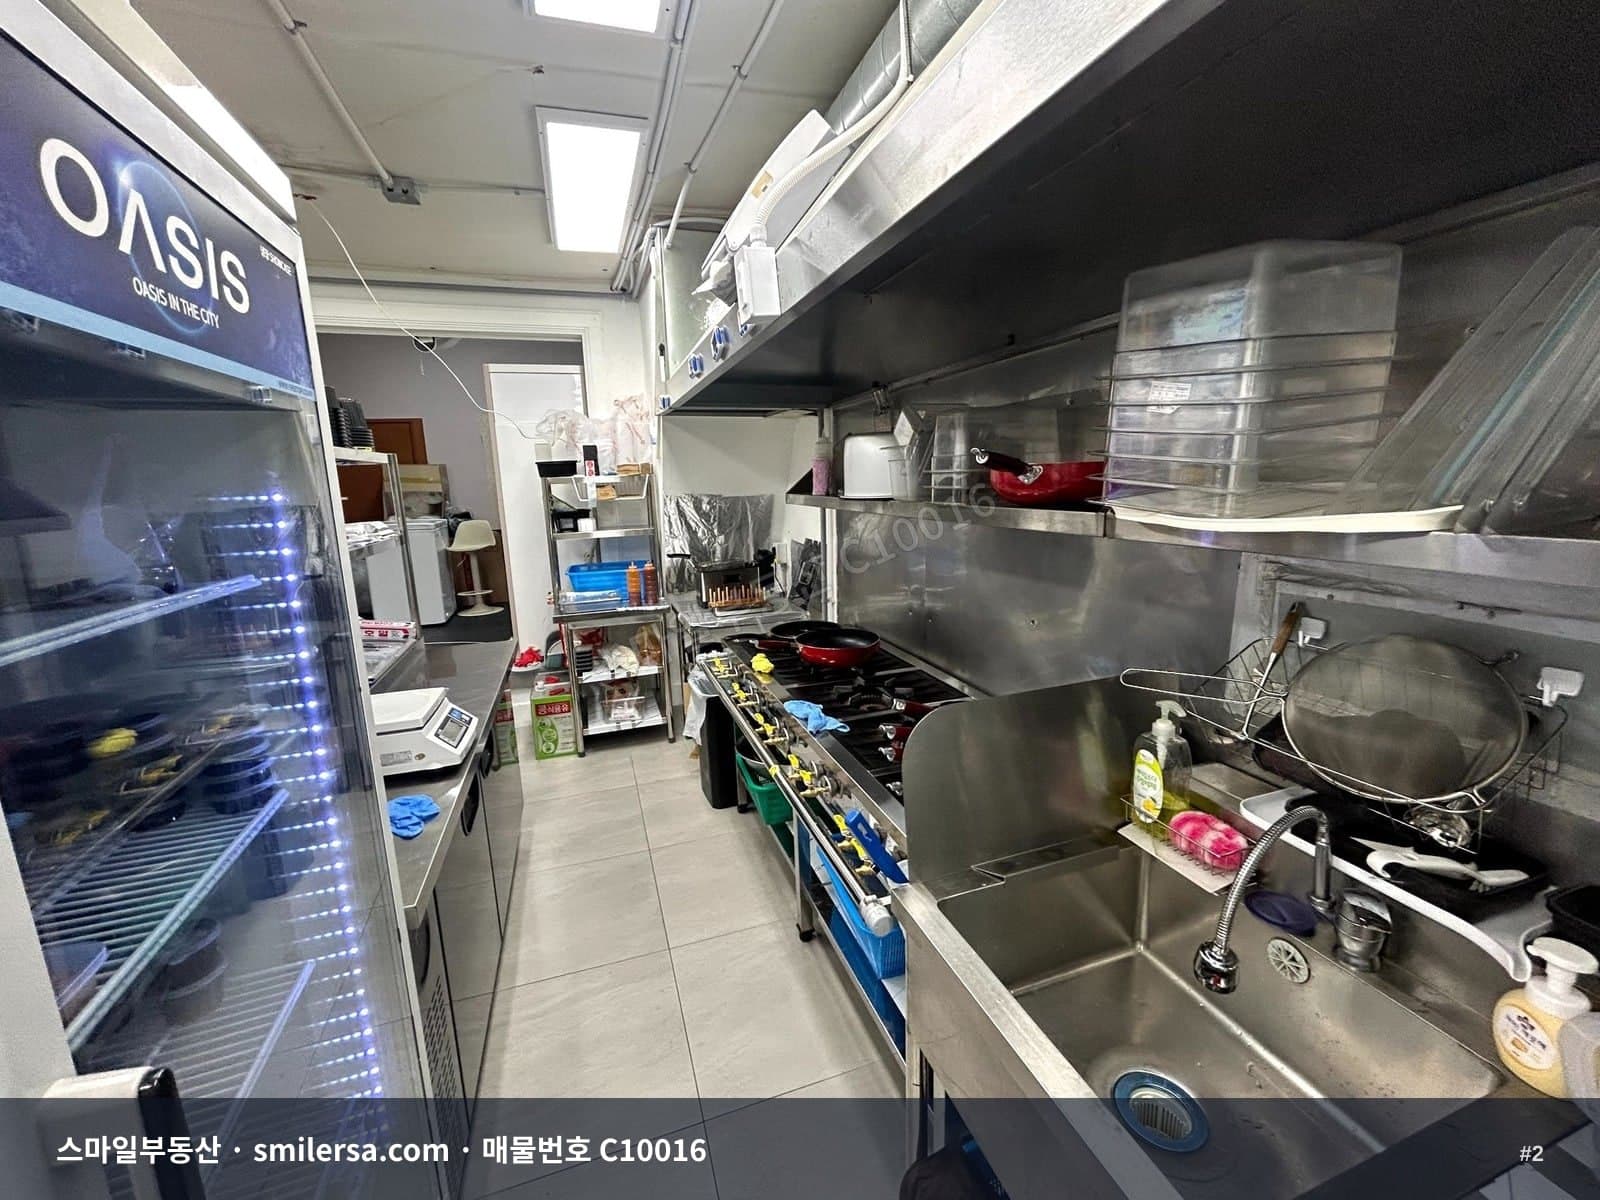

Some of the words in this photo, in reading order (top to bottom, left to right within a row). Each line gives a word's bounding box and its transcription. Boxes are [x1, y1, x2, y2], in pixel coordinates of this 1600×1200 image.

[132, 276, 168, 306] OASIS
[167, 292, 181, 313] IN
[179, 298, 201, 321] THE
[200, 307, 220, 329] CITY
